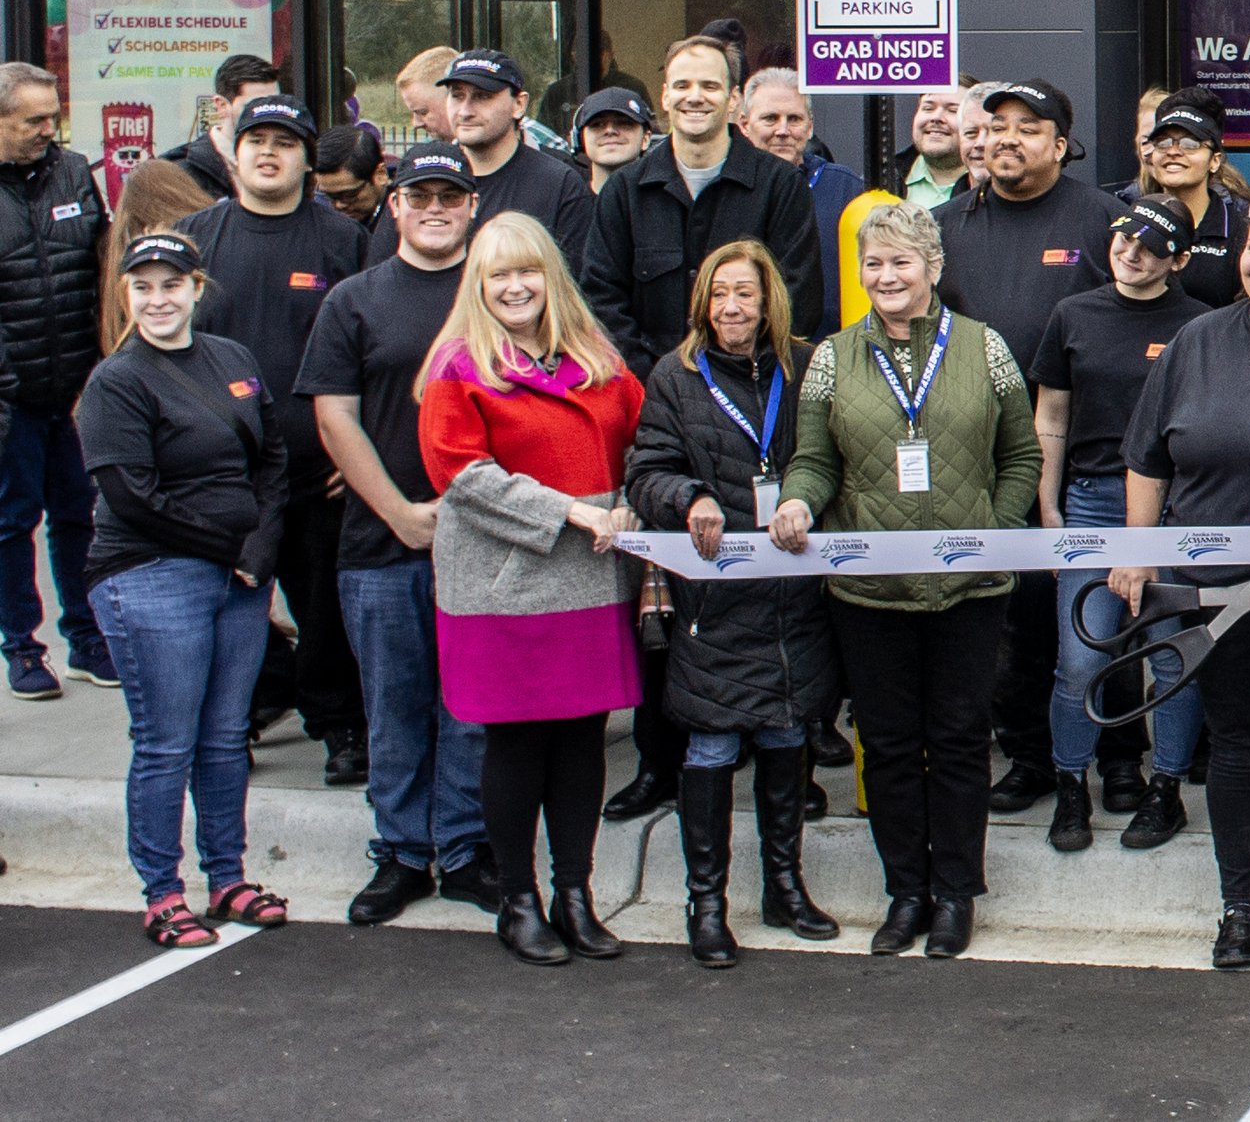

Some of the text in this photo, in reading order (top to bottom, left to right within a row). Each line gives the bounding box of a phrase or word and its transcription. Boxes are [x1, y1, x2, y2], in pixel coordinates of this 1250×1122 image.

[841, 1, 913, 15] PARKING
[111, 17, 247, 28] FLEXIBLE SCHEDULE
[125, 41, 229, 52] SCHOLARSHIPS
[812, 40, 944, 59] GRAB INSIDE
[1196, 37, 1238, 61] We
[116, 67, 154, 78] SAME
[158, 67, 185, 78] DAY
[835, 62, 921, 80] AND GO
[1196, 71, 1215, 79] Start
[1215, 73, 1232, 81] your
[108, 116, 148, 139] FIRE!
[1134, 205, 1155, 219] TACO
[913, 343, 944, 409] AMBASSADOR
[943, 540, 985, 548] CHAMBER
[1188, 536, 1231, 544] CHAMBER
